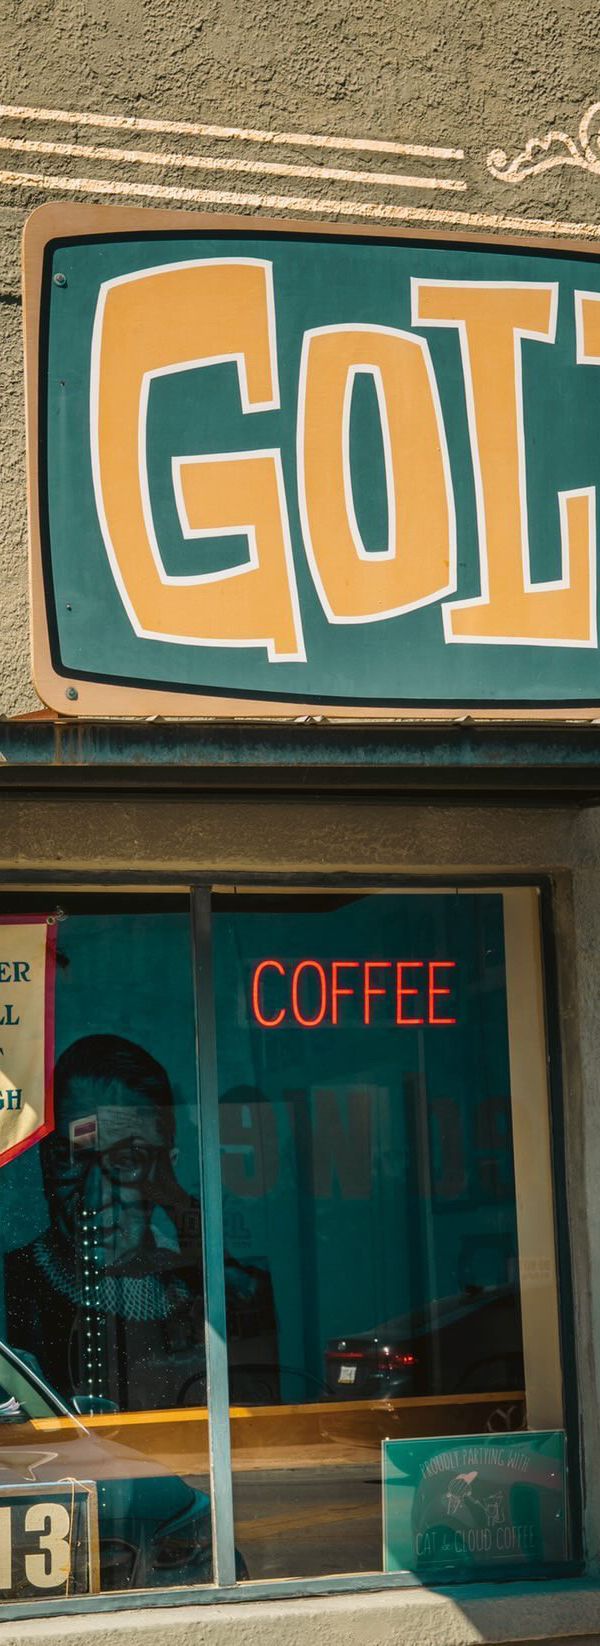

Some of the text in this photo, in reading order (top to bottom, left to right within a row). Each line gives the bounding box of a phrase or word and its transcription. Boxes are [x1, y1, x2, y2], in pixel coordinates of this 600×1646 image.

[90, 257, 600, 662] GOL
[252, 960, 457, 1027] COFFEE
[419, 1448, 531, 1480] PROUDLY PARTYING WITH
[415, 1532, 438, 1556] CAT
[454, 1528, 493, 1553] CLOUD
[496, 1526, 535, 1550] COFFEE
